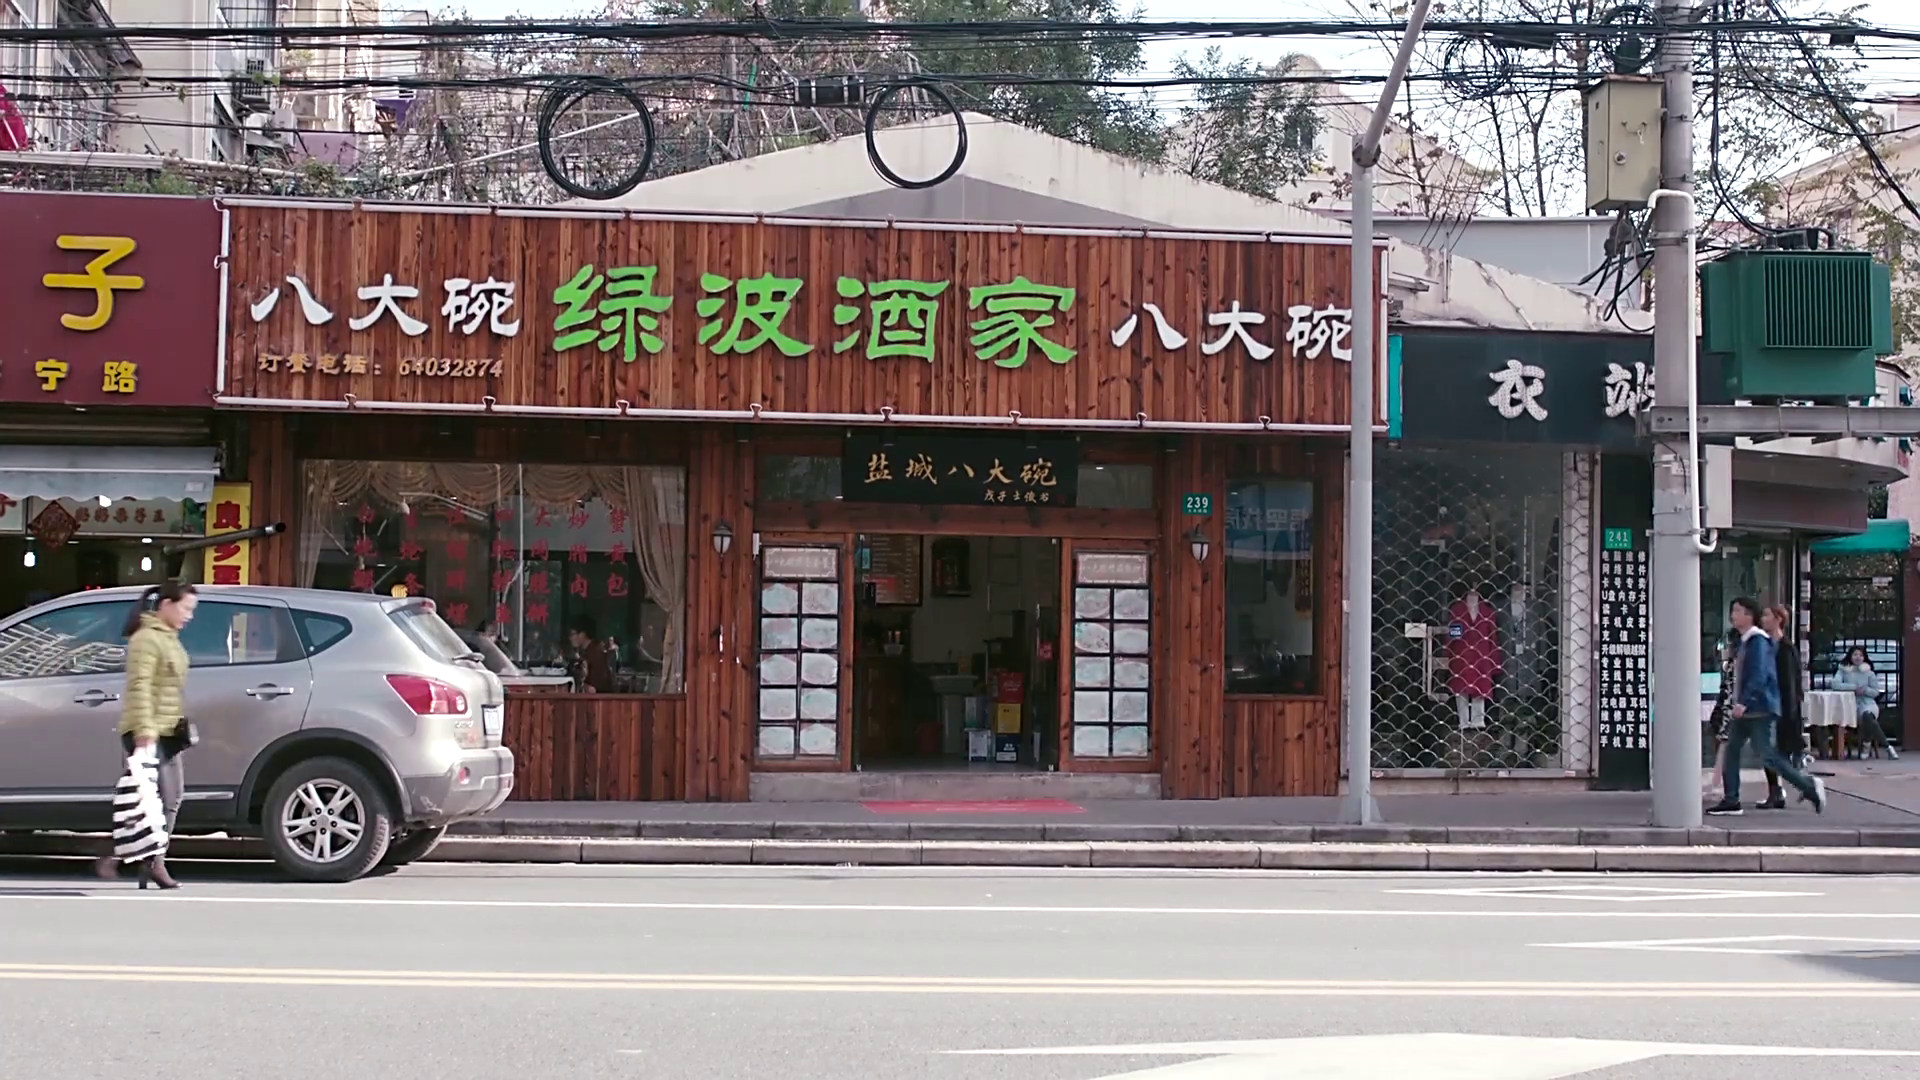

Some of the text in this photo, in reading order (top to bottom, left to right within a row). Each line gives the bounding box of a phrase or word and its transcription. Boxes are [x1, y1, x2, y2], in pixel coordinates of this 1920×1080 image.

[43, 234, 146, 332] 子
[250, 263, 1353, 370] 八大碗 绿波酒家 八大碗
[0, 358, 139, 393] 宁路
[863, 451, 1058, 487] 盐城八大碗
[1187, 497, 1208, 508] 239
[1609, 531, 1628, 542] 241
[1602, 550, 1646, 562] 电脑维修
[1602, 563, 1646, 576] 网络配件
[1601, 590, 1647, 602] U盘内存卡
[1602, 616, 1647, 629] 手机皮套
[1602, 630, 1647, 642] 充值卡
[1601, 657, 1646, 669] 专业贴膜
[1601, 670, 1647, 682] 无线网卡
[1601, 710, 1648, 722] 维修配件
[1600, 736, 1647, 749] 手机置换
